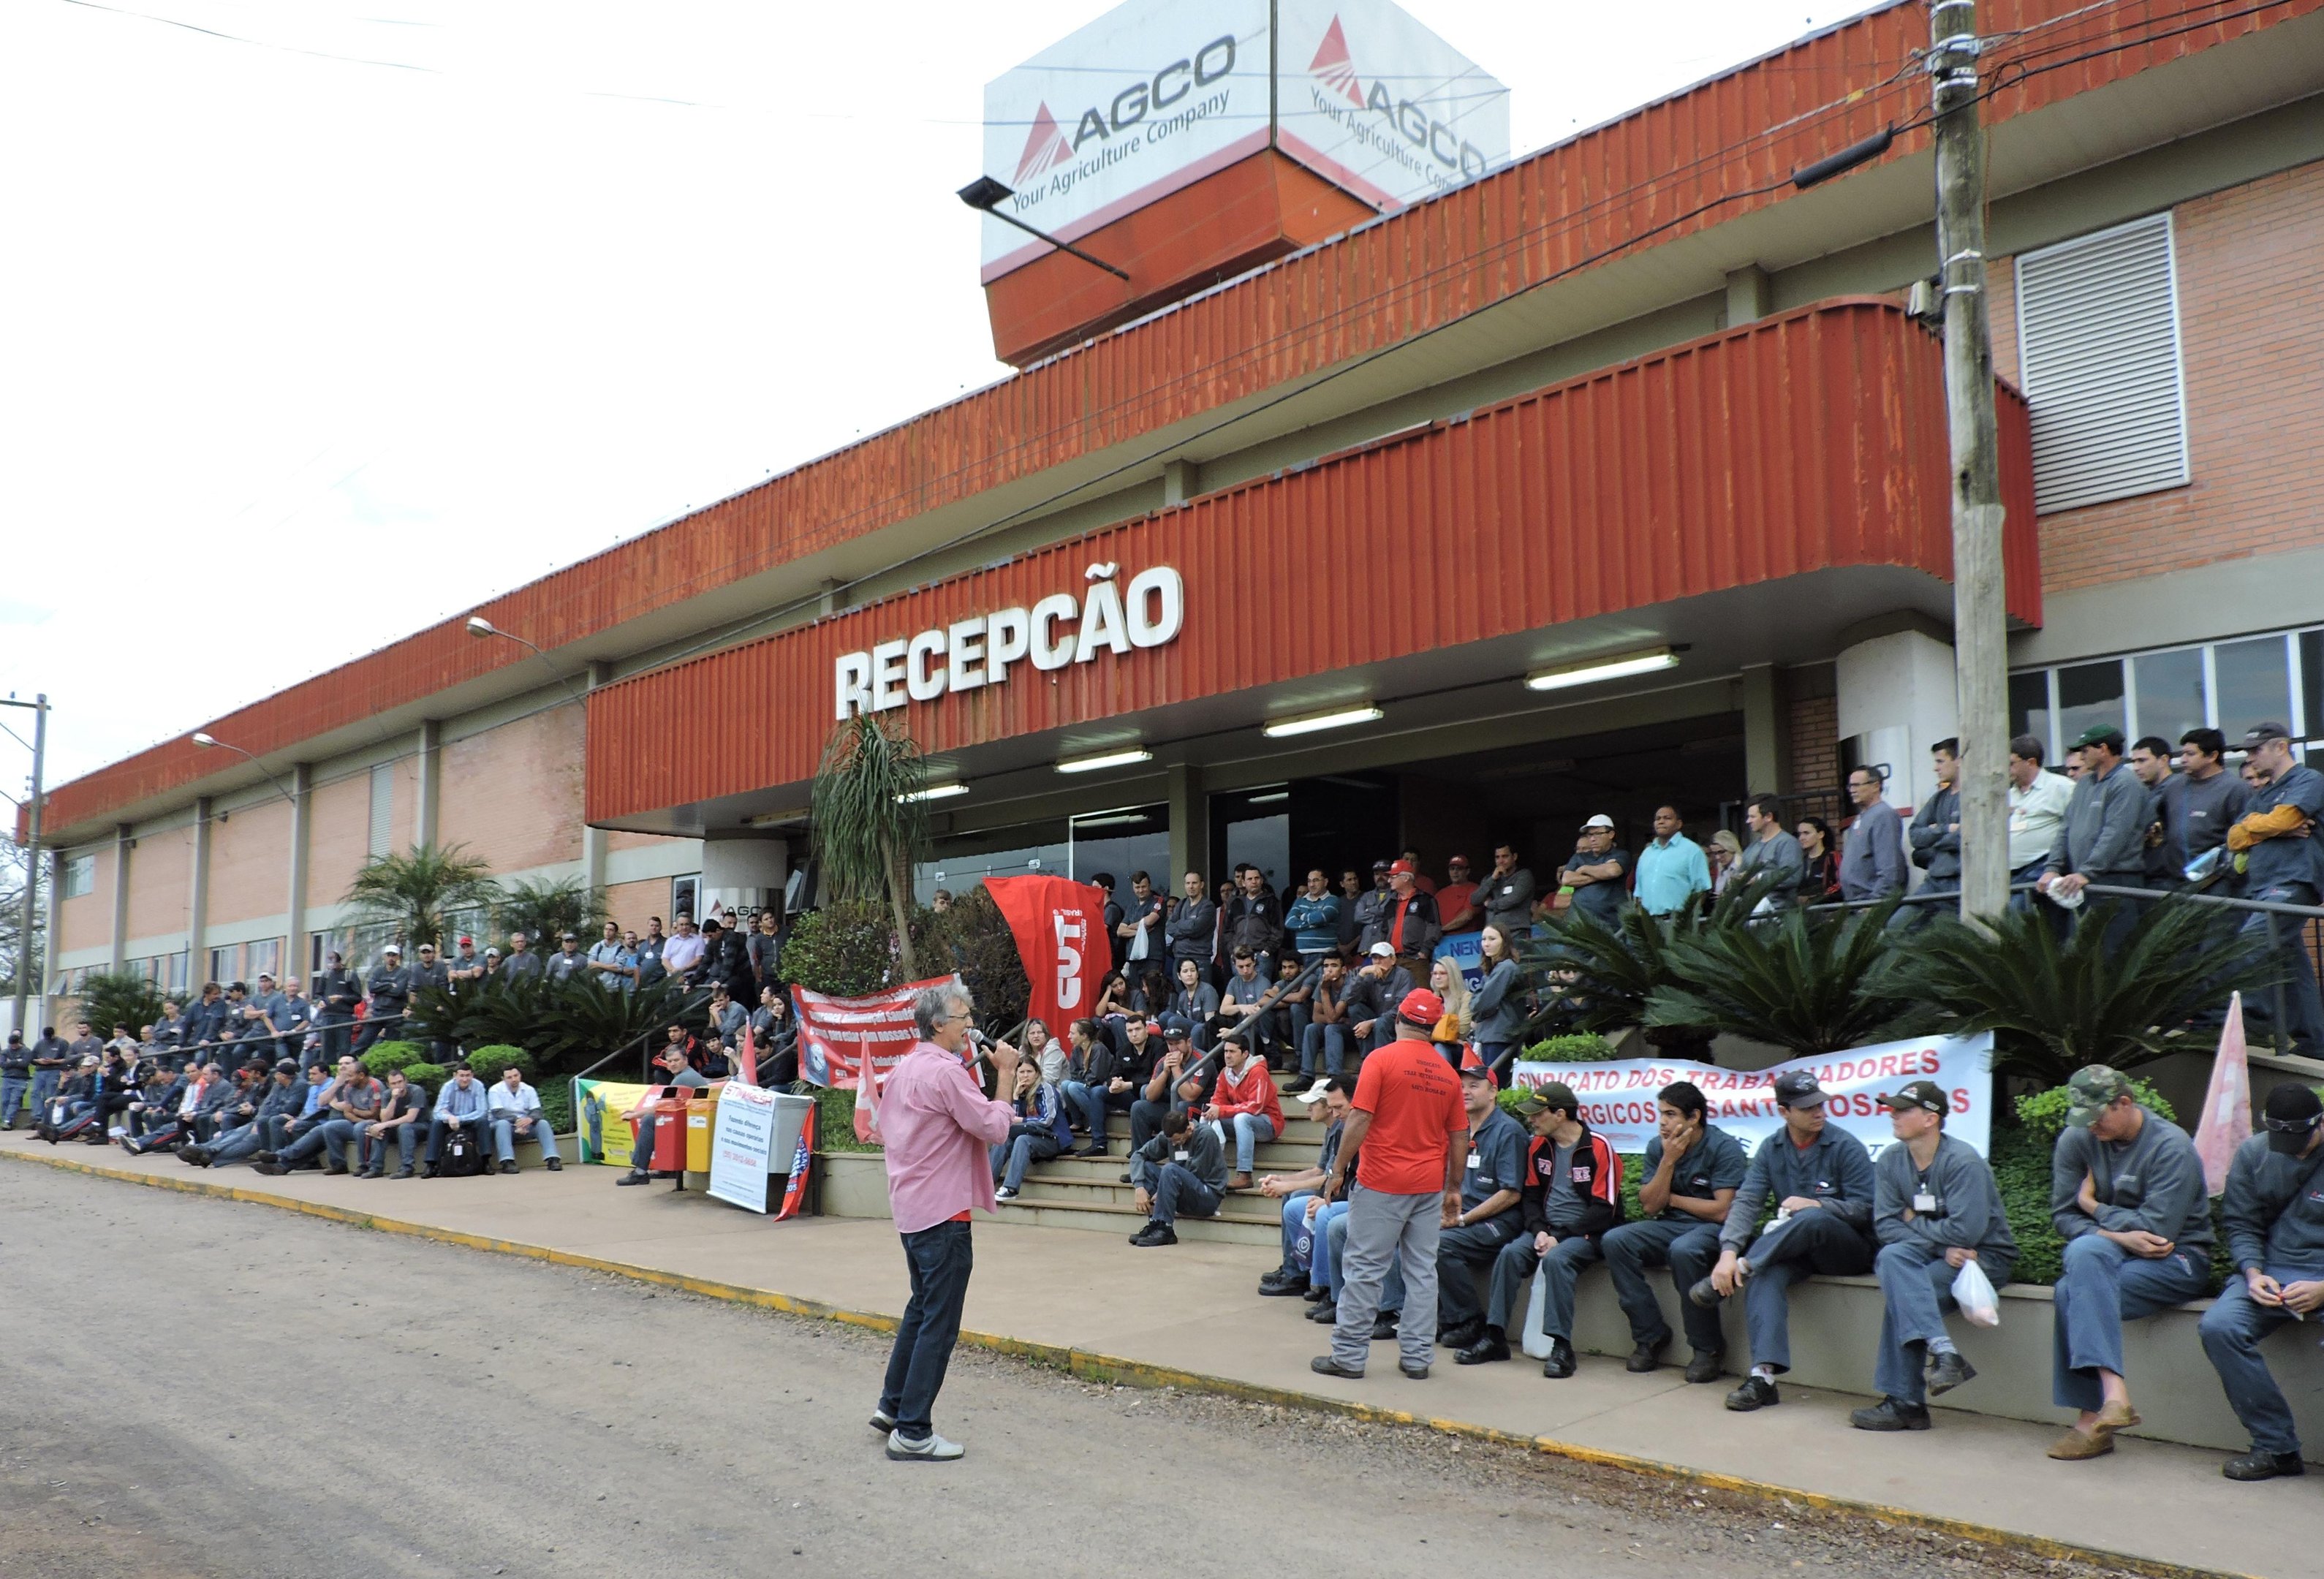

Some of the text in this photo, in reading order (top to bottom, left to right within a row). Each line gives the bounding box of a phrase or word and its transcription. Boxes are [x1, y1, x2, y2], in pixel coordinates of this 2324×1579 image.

[1072, 34, 1236, 154] AGCO
[1311, 86, 1342, 124] Your
[1347, 111, 1422, 177] Agriculture
[1367, 80, 1486, 181] AGCO
[1013, 88, 1230, 213] Your Agriculture Company
[1053, 915, 1081, 1010] CUT
[877, 1029, 911, 1042] nossas
[885, 1007, 915, 1022] saudá
[1518, 1049, 1940, 1092] SINDICATO DOS TRABAADORES
[1706, 1097, 1777, 1119] SANT
